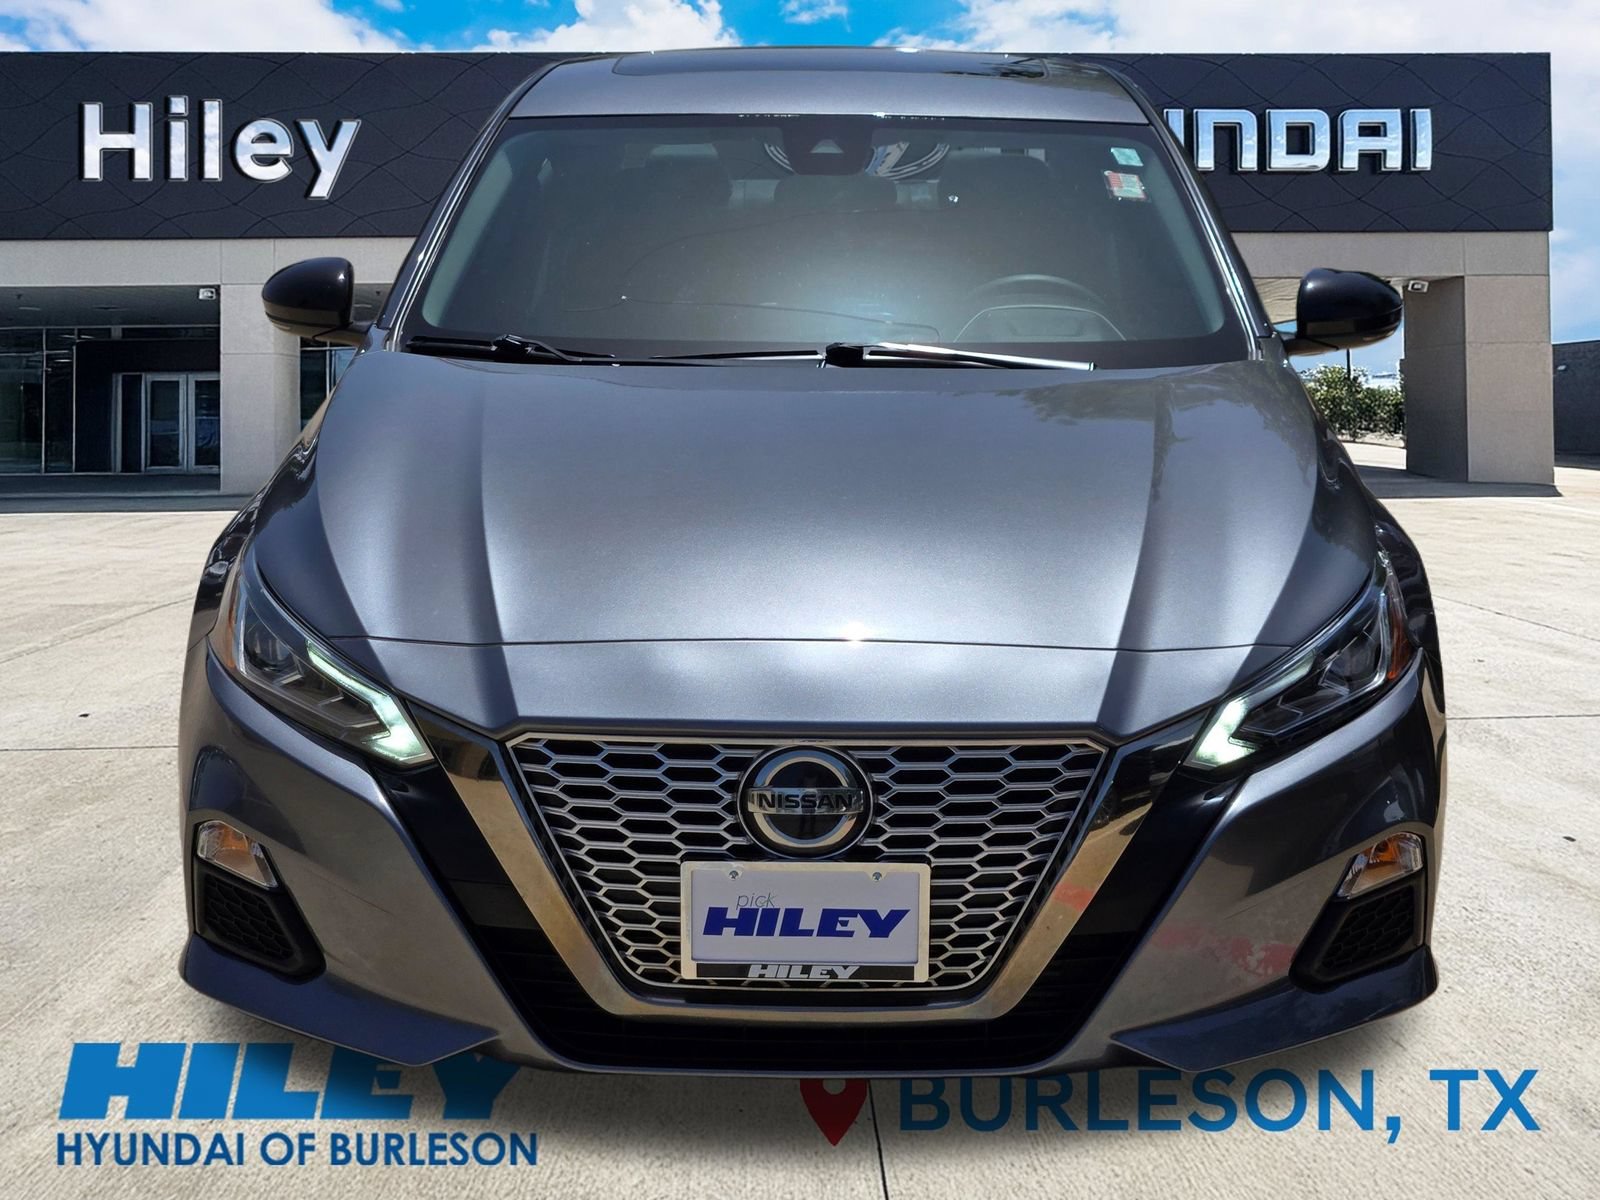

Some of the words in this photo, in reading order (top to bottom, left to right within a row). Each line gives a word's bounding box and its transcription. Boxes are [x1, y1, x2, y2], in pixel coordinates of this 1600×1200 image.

[79, 95, 361, 200] Hiley
[757, 791, 852, 810] NISSAN
[736, 892, 777, 910] pick
[702, 906, 911, 939] HILEY
[747, 964, 860, 980] HILEY
